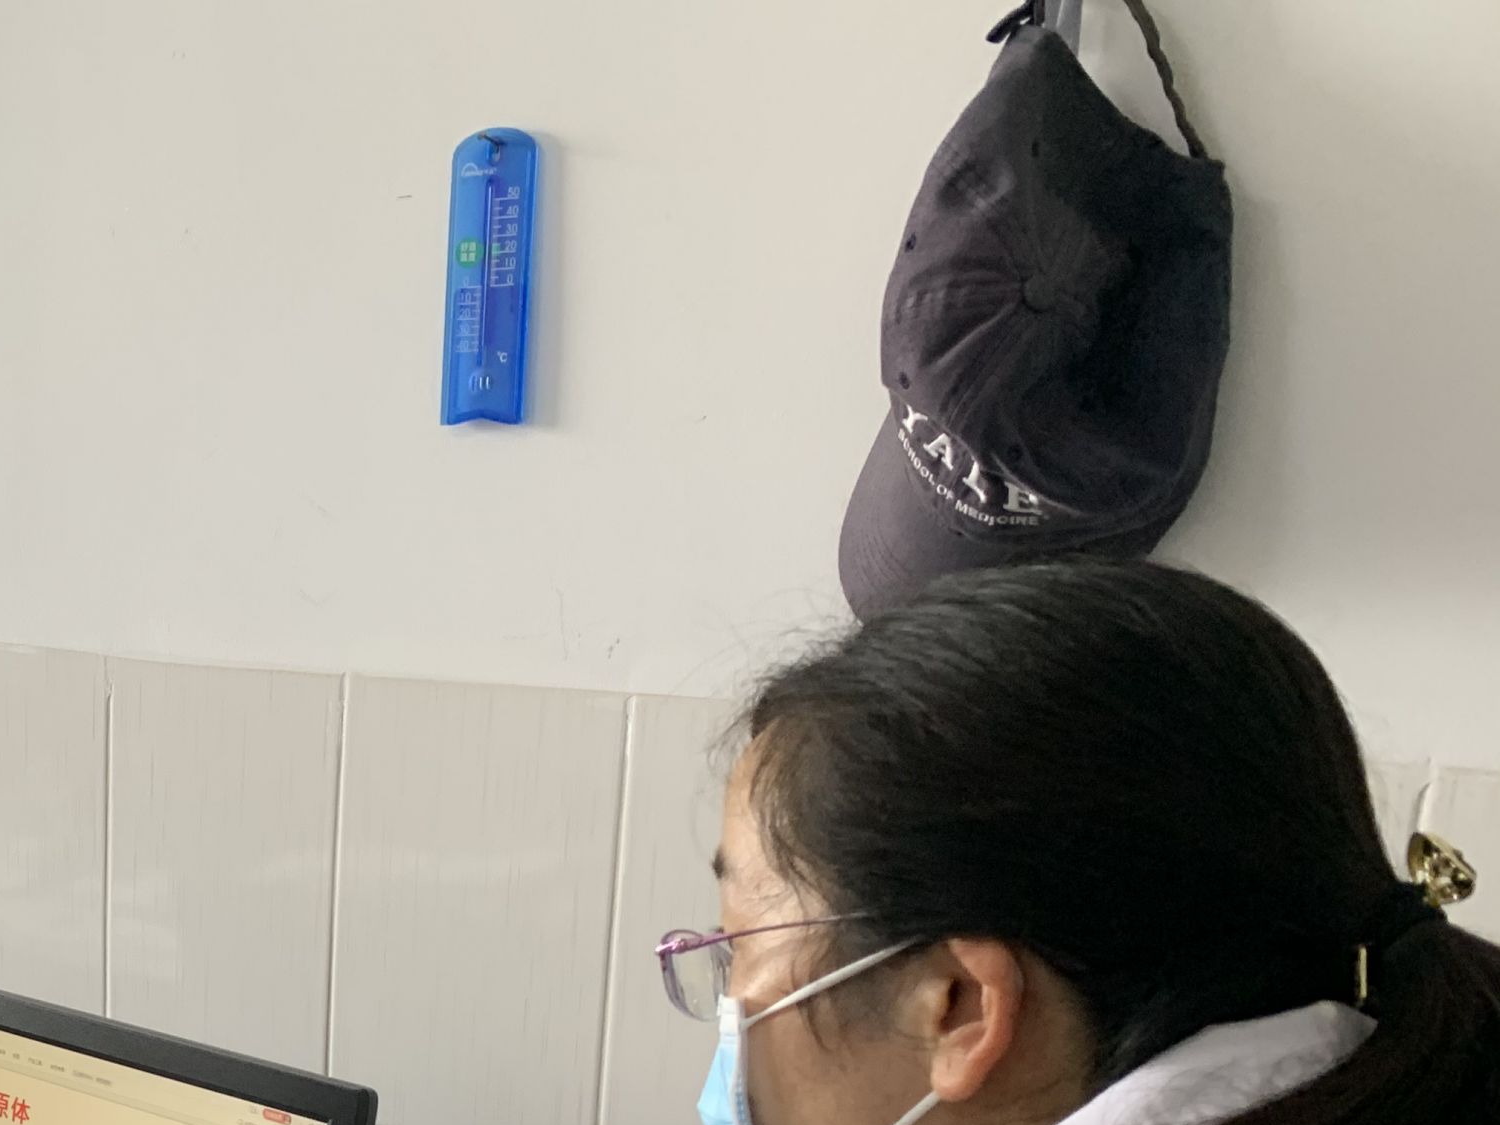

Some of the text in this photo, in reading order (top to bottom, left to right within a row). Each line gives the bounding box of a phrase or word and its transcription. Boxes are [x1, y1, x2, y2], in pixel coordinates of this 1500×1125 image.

[508, 187, 520, 198] 50
[507, 205, 519, 216] 40
[506, 223, 518, 234] 30
[505, 241, 517, 252] 20
[505, 258, 516, 268] 10
[507, 274, 514, 284] 0
